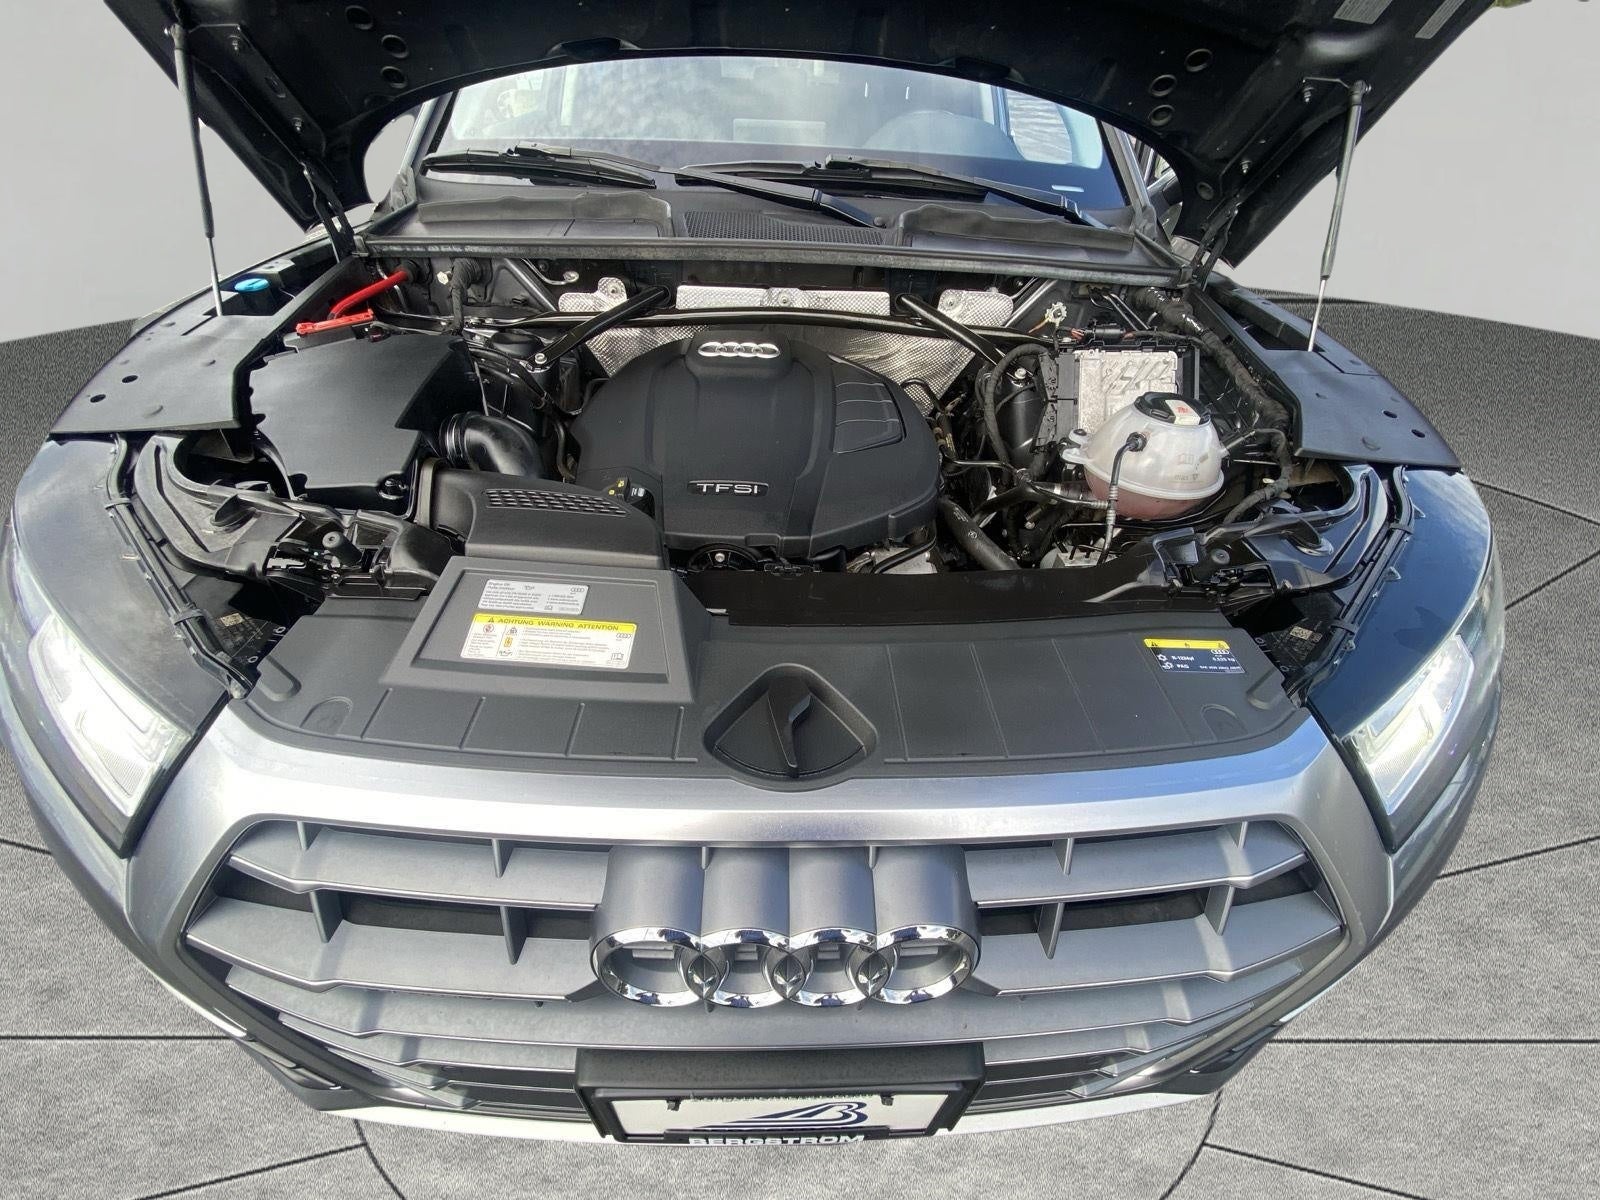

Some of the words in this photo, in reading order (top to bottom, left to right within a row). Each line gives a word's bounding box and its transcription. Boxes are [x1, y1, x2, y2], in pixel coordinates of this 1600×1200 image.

[697, 483, 758, 494] TFSI
[498, 617, 534, 626] ACHTUNG
[538, 620, 574, 629] WARNING
[577, 623, 619, 631] ATTENTION
[689, 1134, 865, 1145] BERGSTROM
